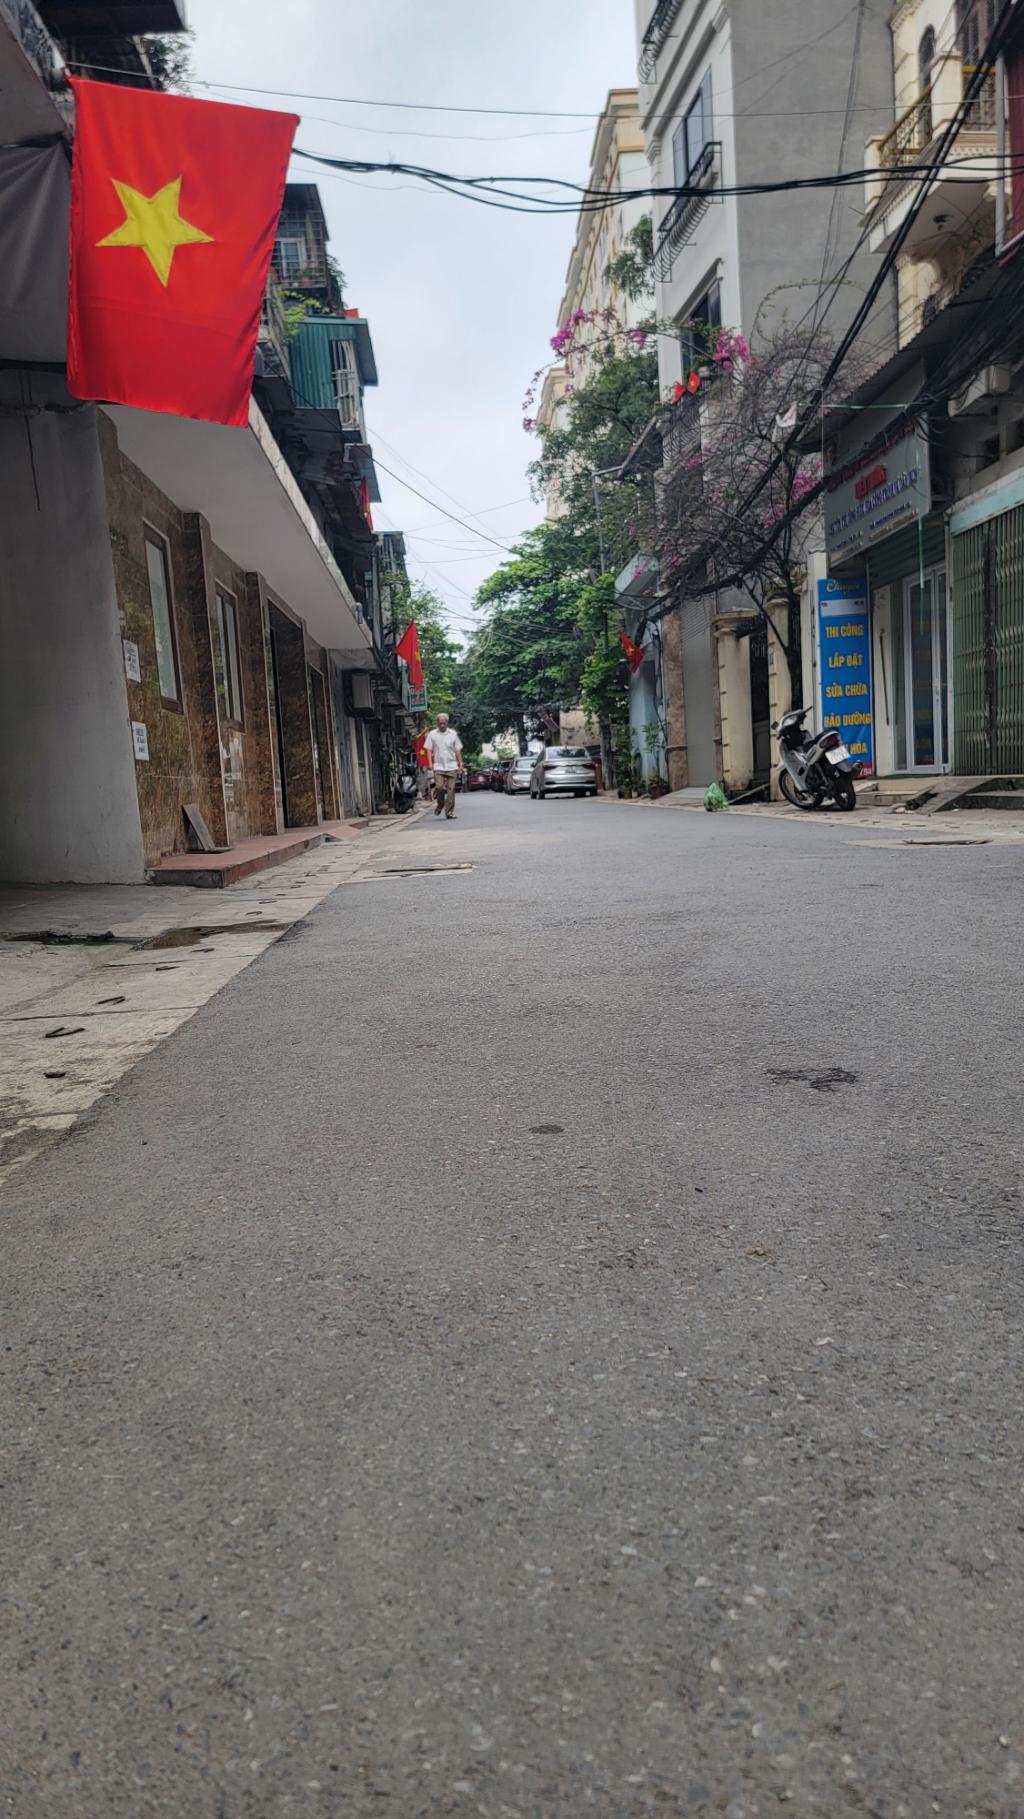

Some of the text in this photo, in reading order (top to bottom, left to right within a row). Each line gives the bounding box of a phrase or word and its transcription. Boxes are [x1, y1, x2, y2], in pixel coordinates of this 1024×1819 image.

[826, 623, 864, 639] THI CÔNG
[826, 682, 868, 698] SỬA CHỮA
[824, 712, 840, 728] BẢO
